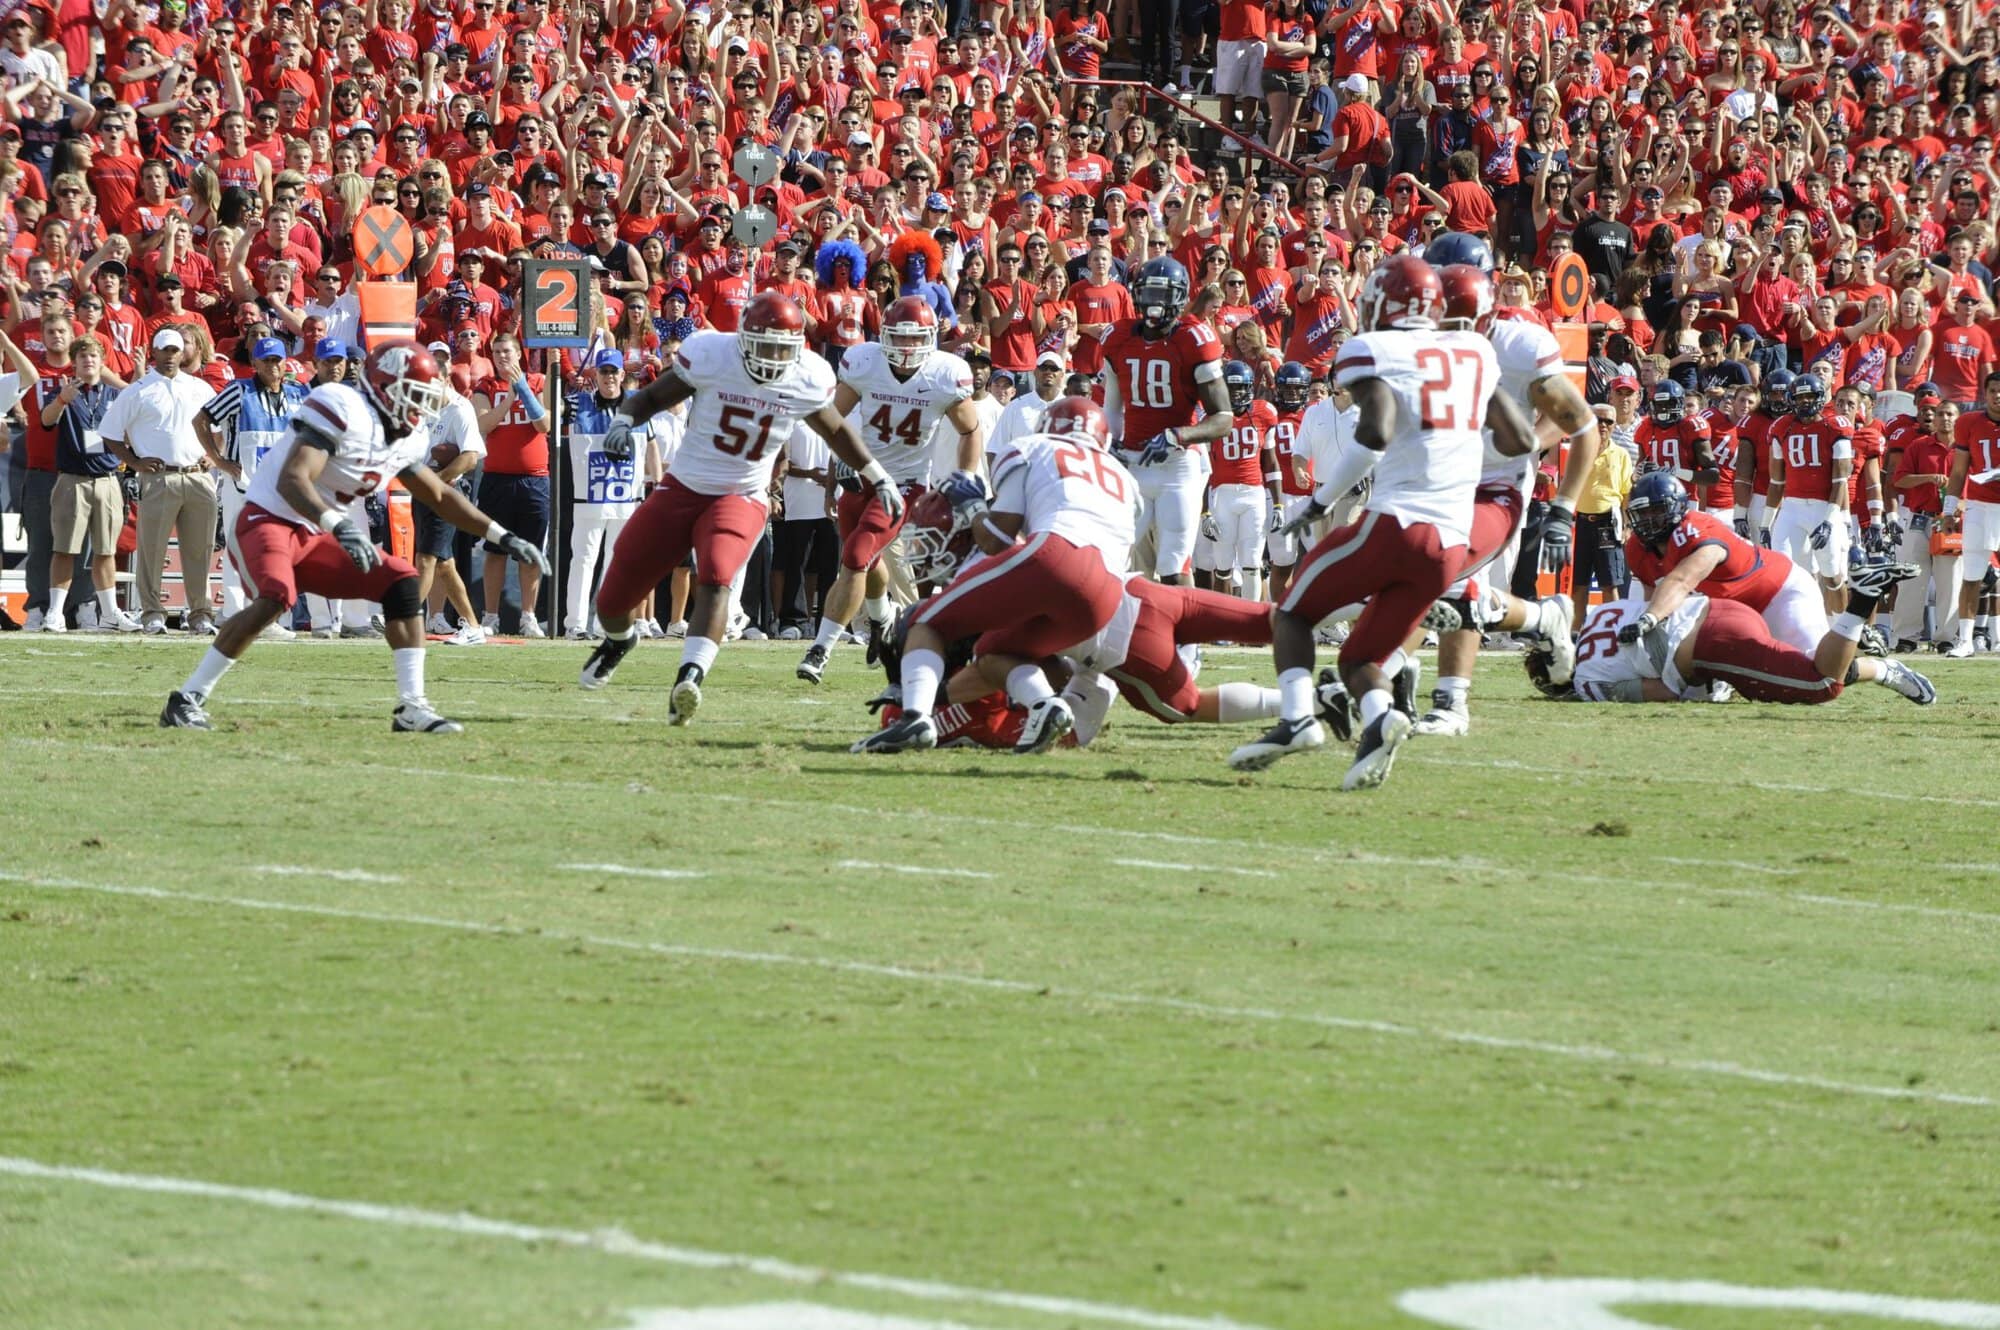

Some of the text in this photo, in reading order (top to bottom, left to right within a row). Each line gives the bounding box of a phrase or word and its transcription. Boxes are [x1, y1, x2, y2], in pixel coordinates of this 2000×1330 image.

[745, 150, 766, 160] Telex
[744, 210, 766, 220] Telex
[536, 267, 578, 323] 2
[1188, 323, 1216, 346] 18
[871, 392, 930, 407] WASHINGTON STATE
[1126, 358, 1174, 408] 18
[1415, 347, 1485, 433] 27
[719, 392, 790, 415] WASHINGTON STATE
[713, 405, 774, 461] 51
[870, 404, 922, 446] 44
[1222, 426, 1259, 460] 89
[1652, 439, 1680, 472] 19
[1788, 433, 1822, 467] 81
[590, 462, 634, 481] PAC
[1054, 445, 1126, 503] 26
[590, 481, 634, 502] 10
[1673, 523, 1699, 547] 64
